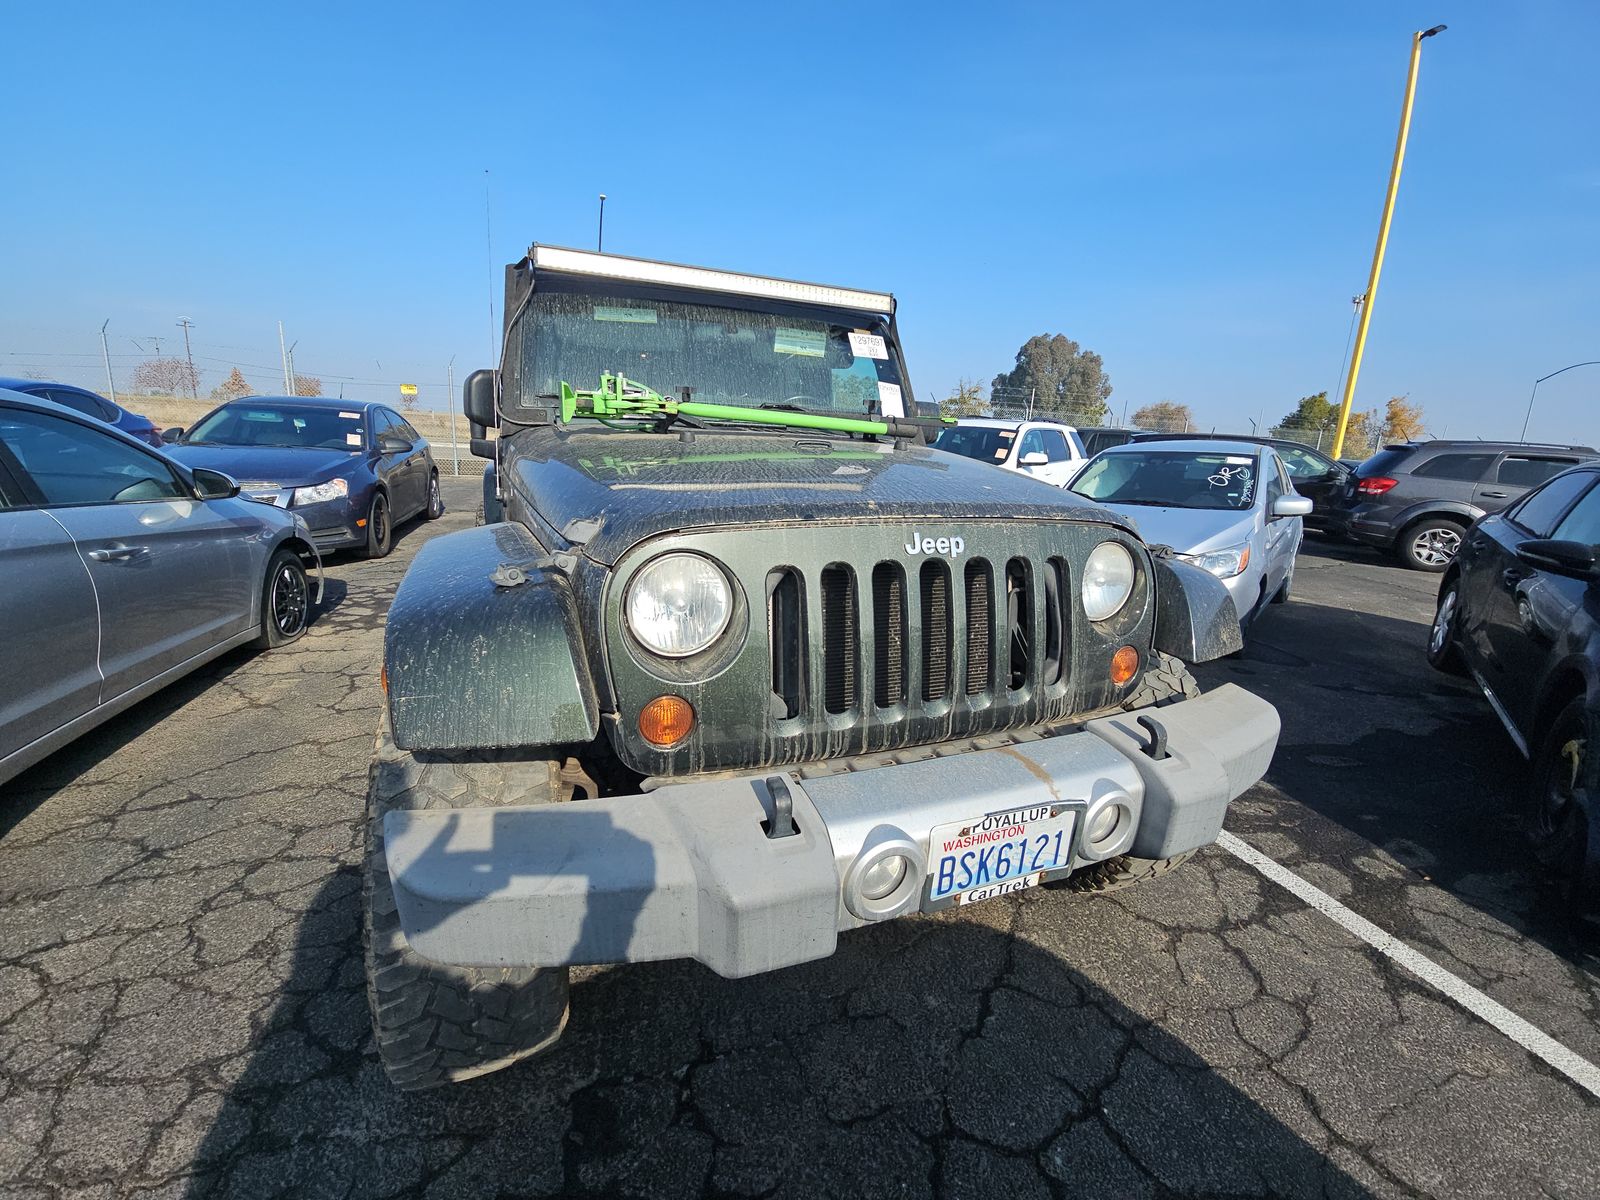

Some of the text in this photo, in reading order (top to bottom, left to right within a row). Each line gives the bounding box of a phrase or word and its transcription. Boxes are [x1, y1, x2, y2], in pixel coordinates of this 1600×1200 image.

[854, 335, 883, 347] 1297697
[904, 532, 965, 558] Jeep
[943, 825, 1025, 852] WASHINGTON
[937, 830, 1063, 896] BSK6121
[967, 877, 1031, 902] CarTrek
